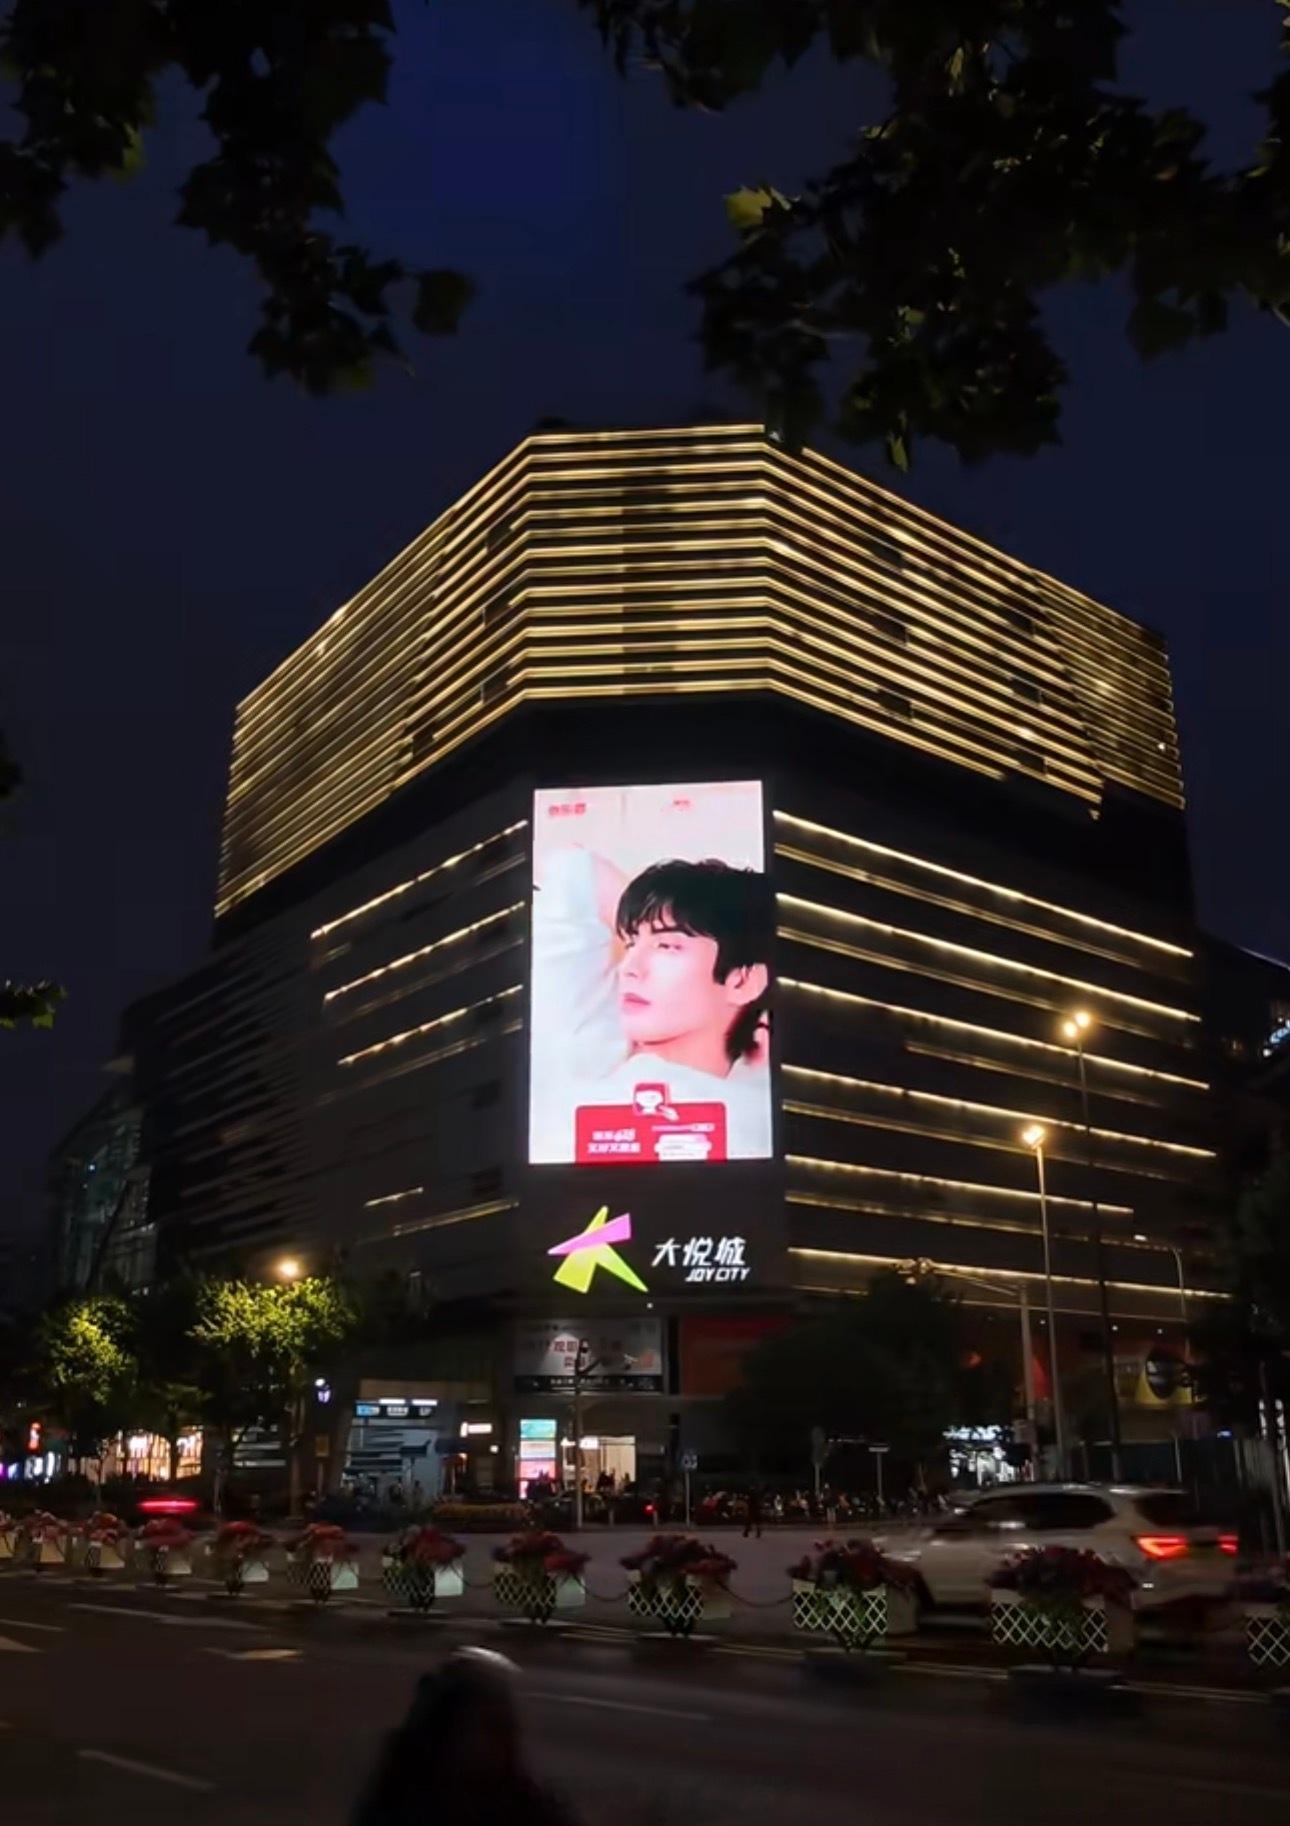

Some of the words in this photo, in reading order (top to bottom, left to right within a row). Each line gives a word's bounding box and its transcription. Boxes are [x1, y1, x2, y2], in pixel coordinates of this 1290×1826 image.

[651, 1236, 746, 1267] 大悦城
[685, 1267, 716, 1282] JOY
[715, 1267, 751, 1281] CITY
